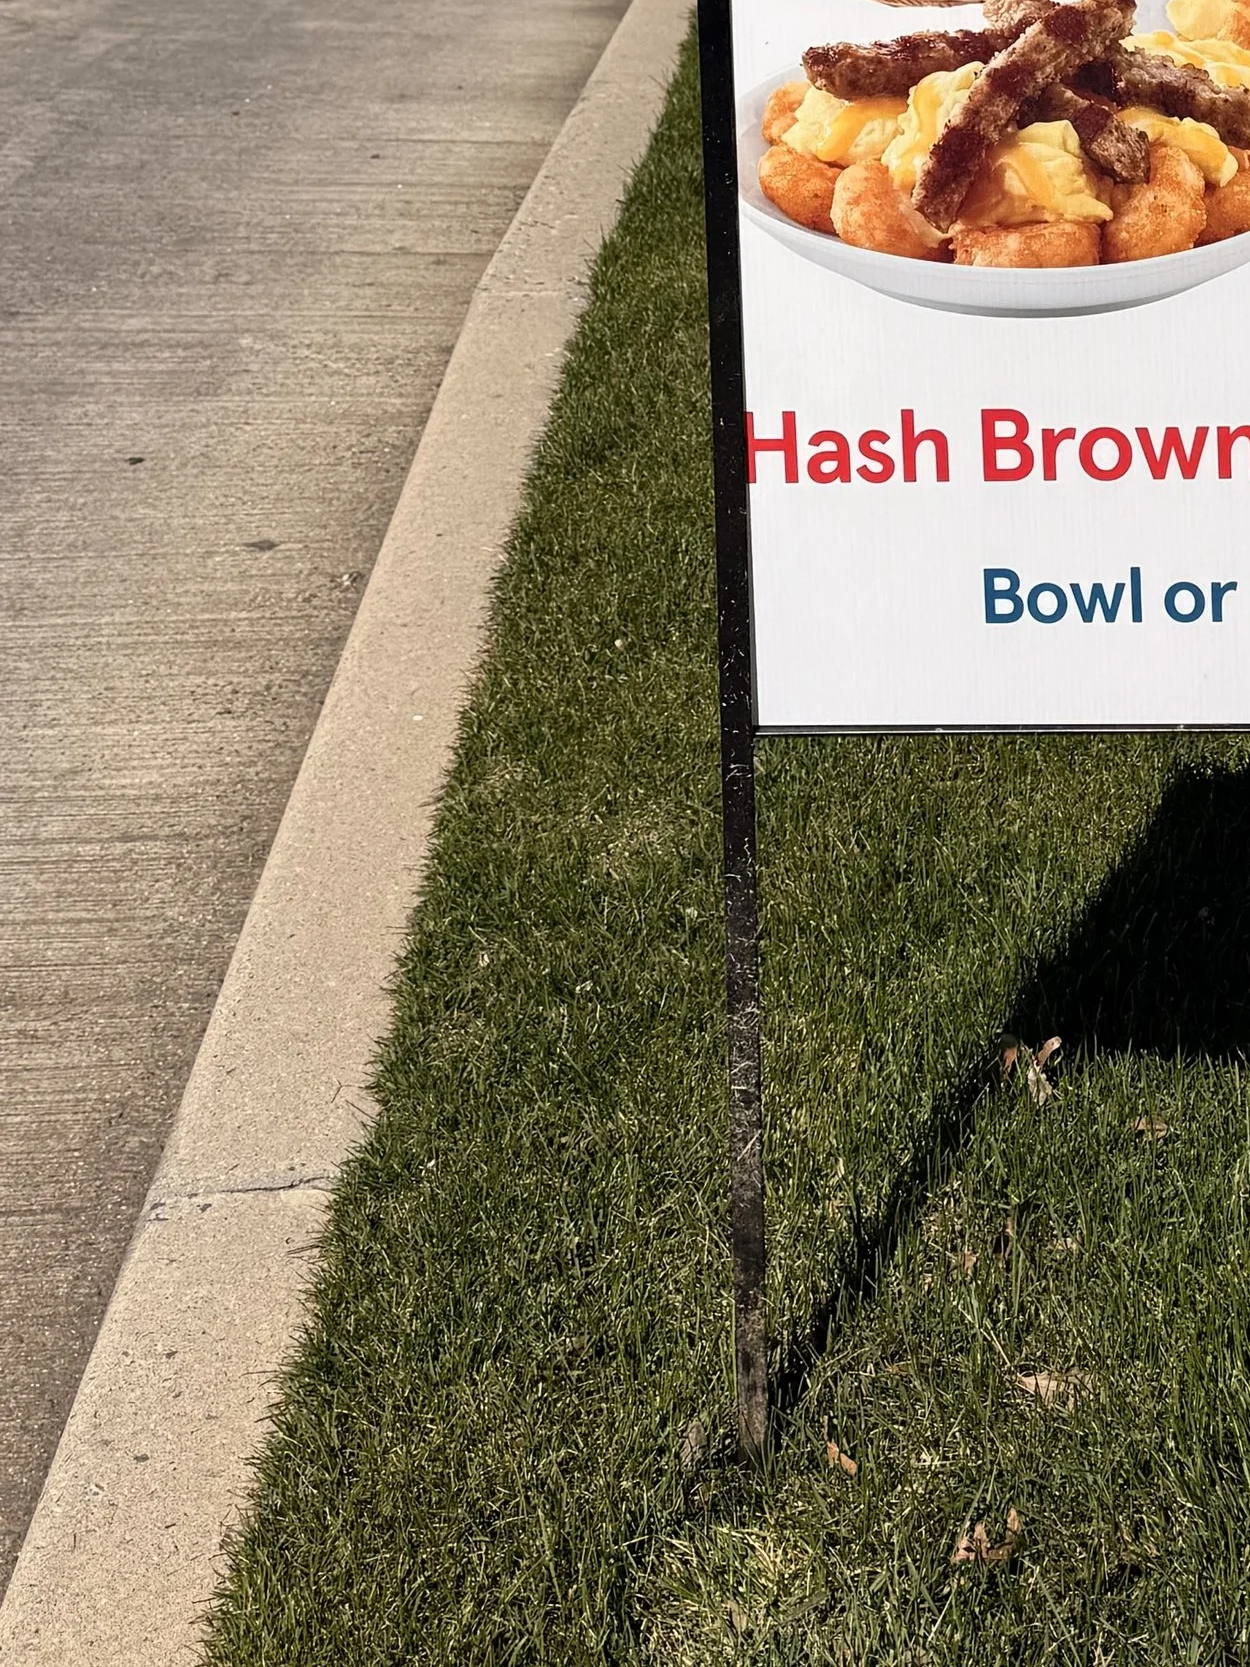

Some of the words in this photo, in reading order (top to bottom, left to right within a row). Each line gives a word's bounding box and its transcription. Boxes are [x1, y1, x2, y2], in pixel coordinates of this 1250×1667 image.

[744, 409, 950, 485] Hash
[984, 567, 1142, 624] Bowl
[1165, 582, 1234, 624] or
